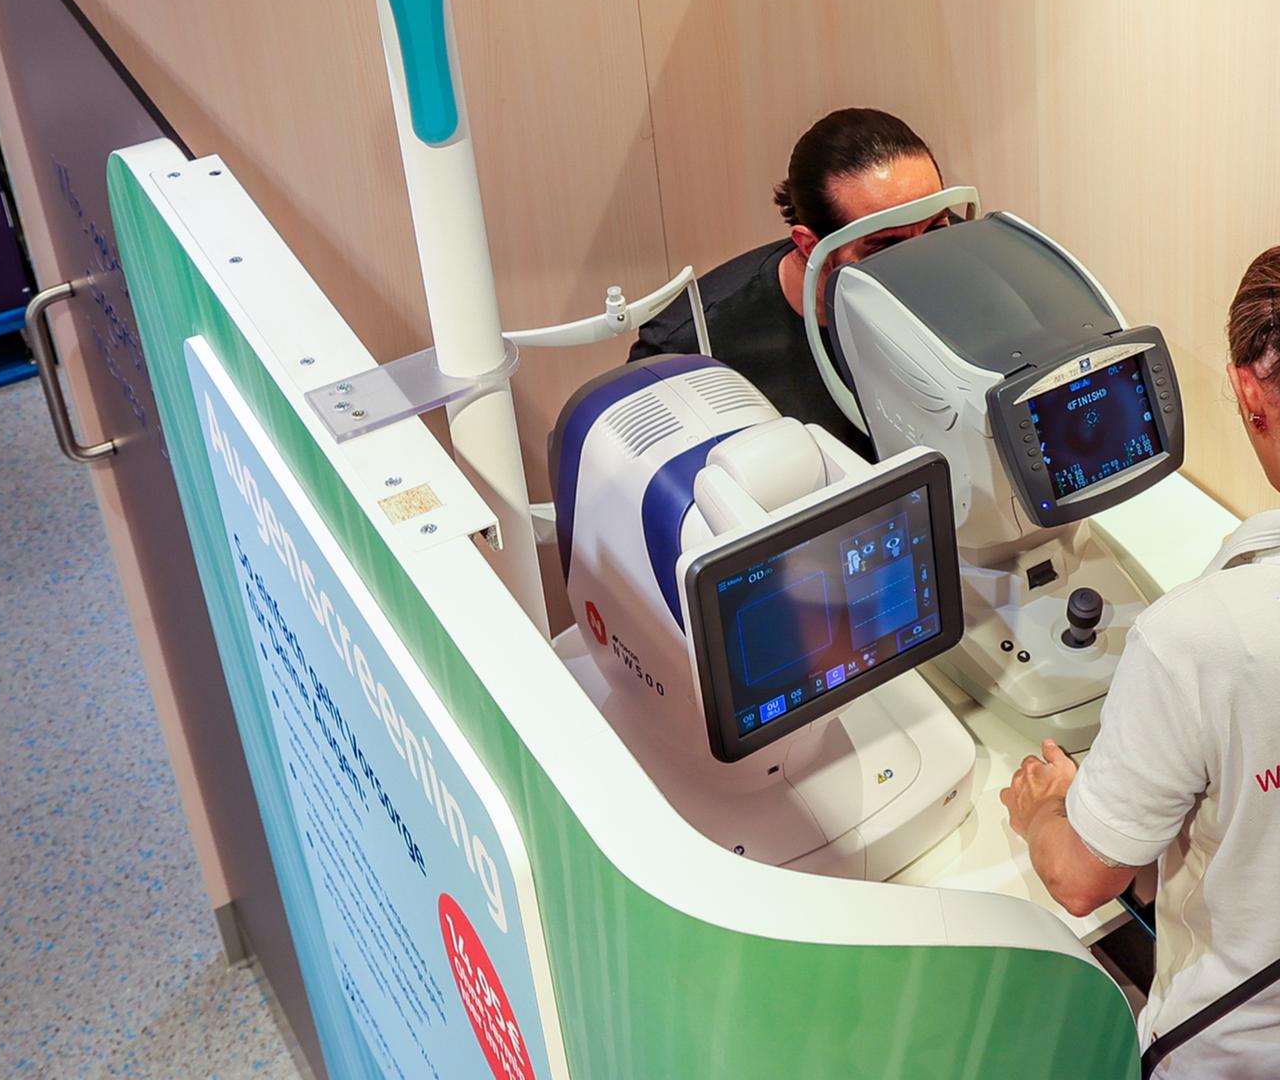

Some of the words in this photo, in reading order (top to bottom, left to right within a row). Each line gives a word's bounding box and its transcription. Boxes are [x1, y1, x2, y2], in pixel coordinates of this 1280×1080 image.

[204, 391, 508, 934] Augenscreening
[309, 666, 346, 740] geht
[345, 721, 426, 877] Vorsorge
[313, 699, 369, 812] Augen:
[446, 915, 505, 1031] 14,95
